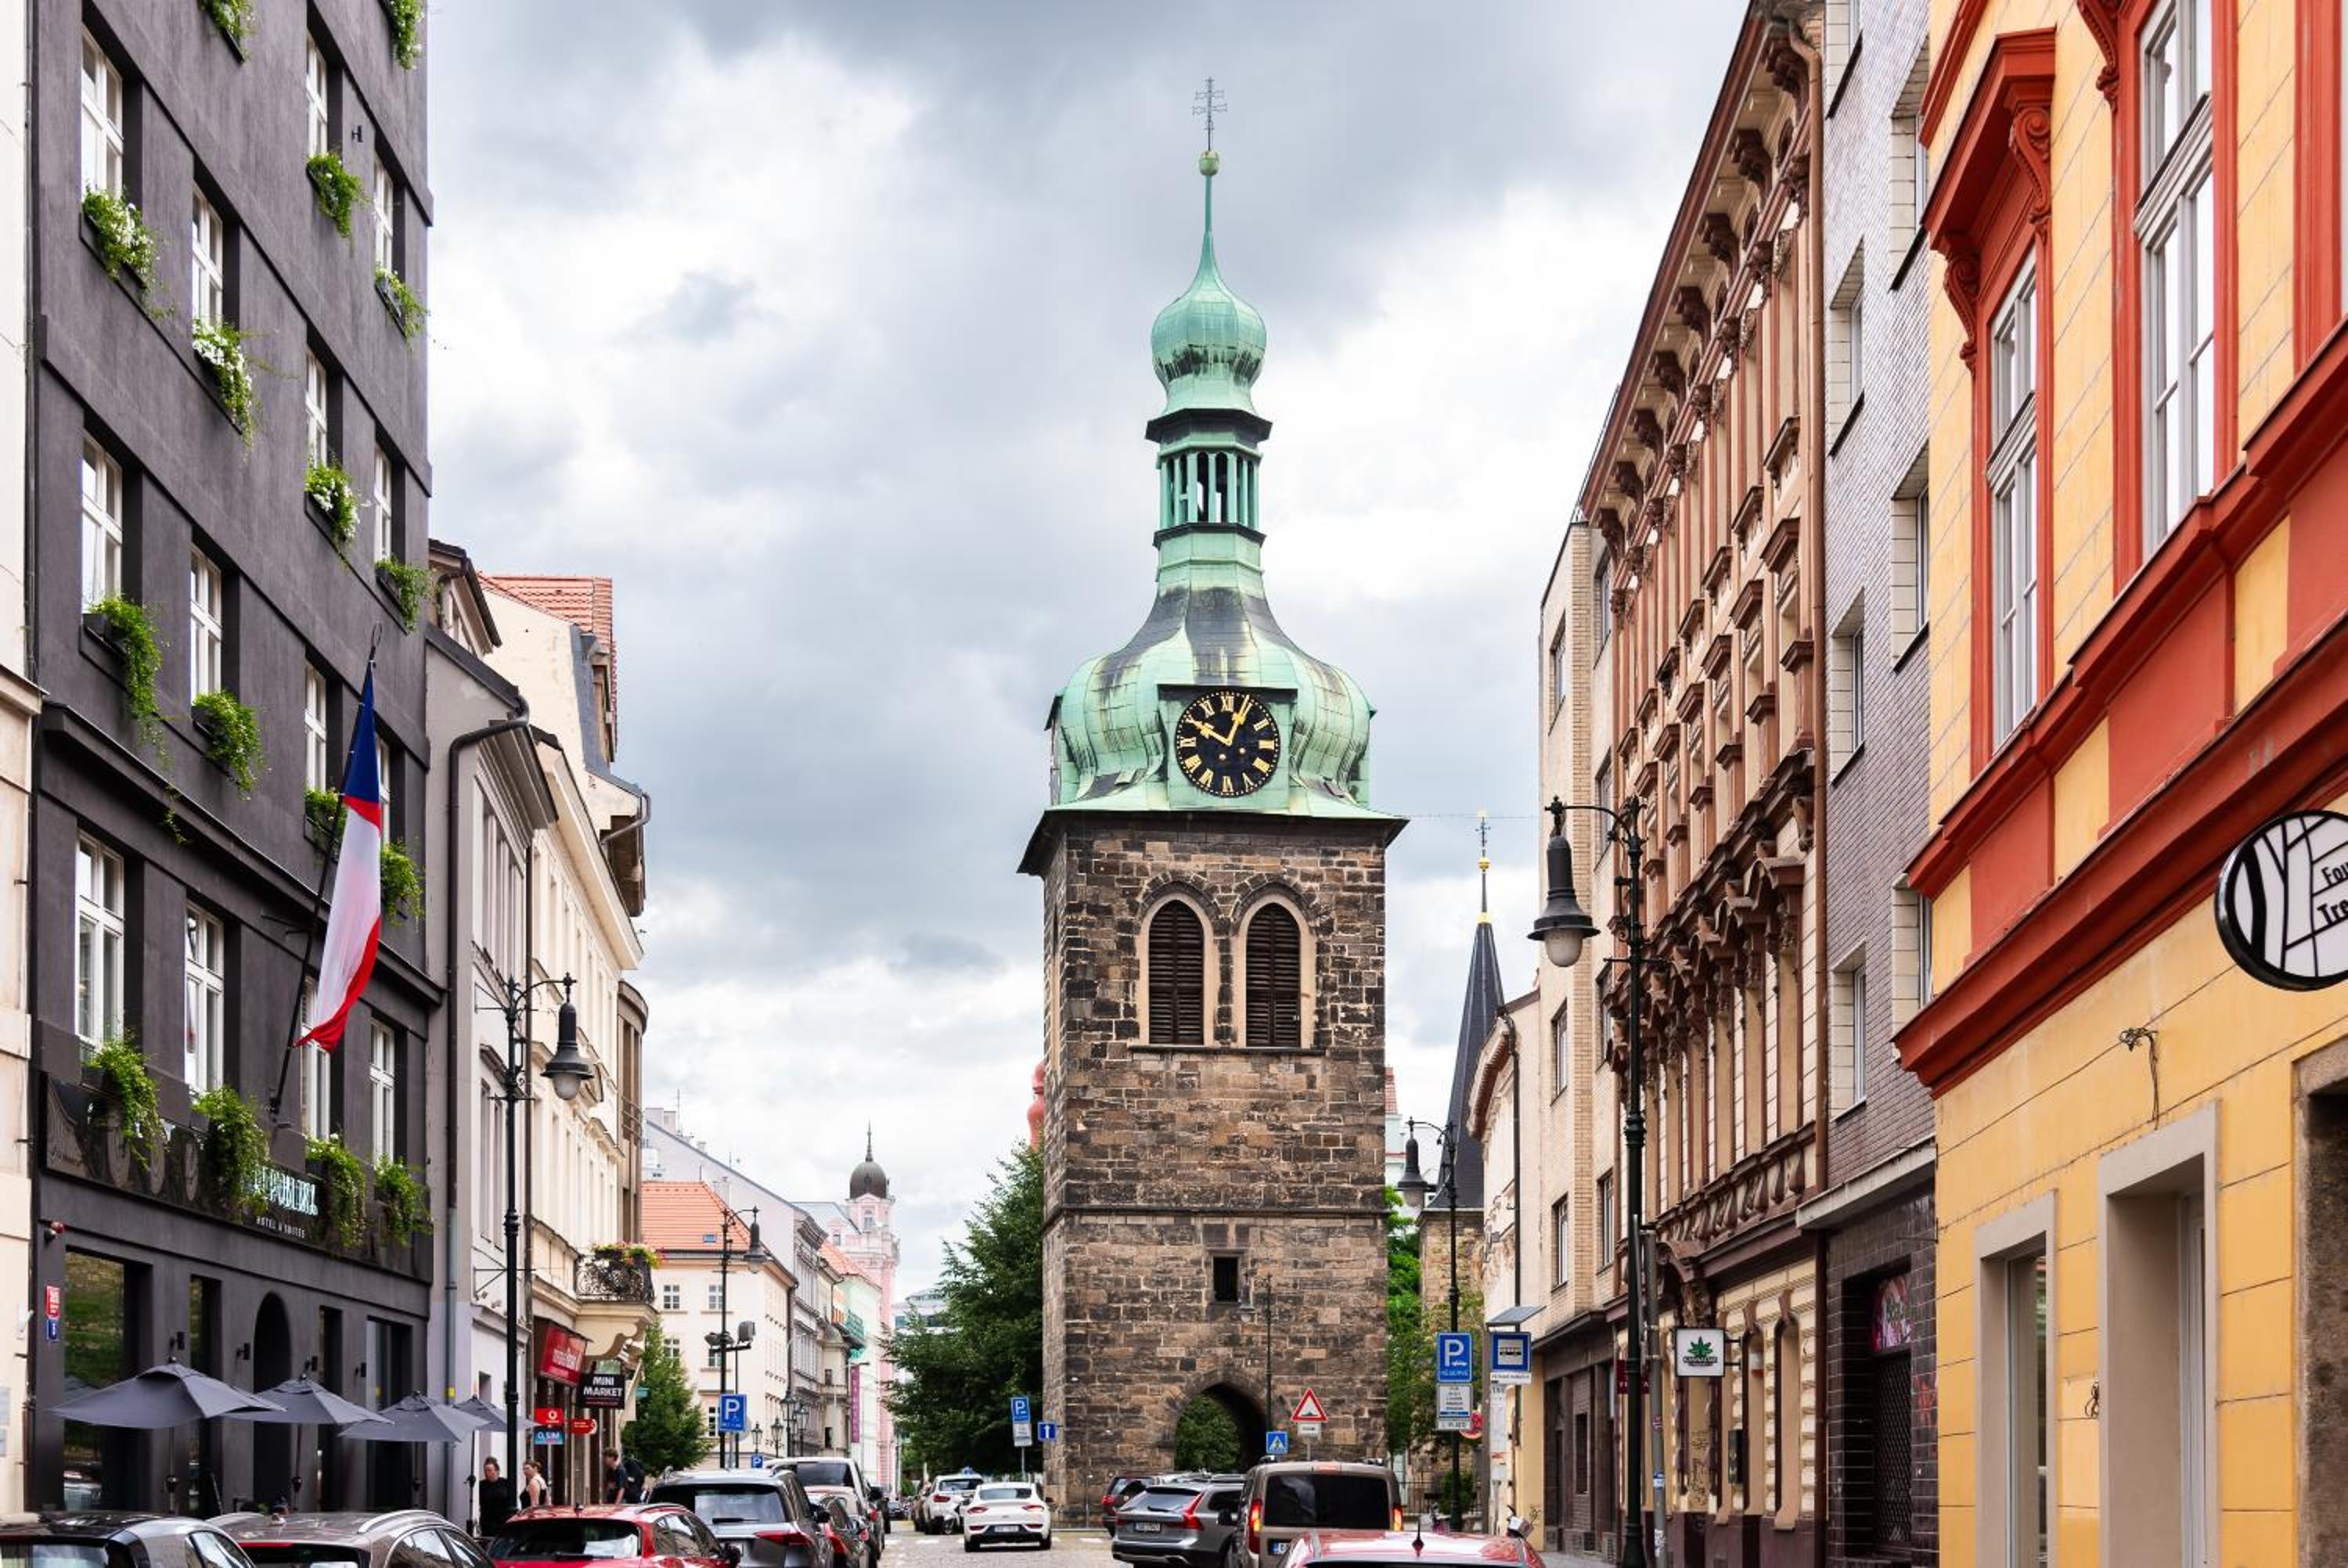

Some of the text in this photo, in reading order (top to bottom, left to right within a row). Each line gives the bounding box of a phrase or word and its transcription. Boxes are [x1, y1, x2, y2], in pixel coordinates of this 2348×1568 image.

[1220, 696, 1234, 713] XII
[1444, 1339, 1464, 1367] P
[592, 1376, 614, 1386] MINI
[583, 1386, 623, 1397] MARKET
[725, 1398, 740, 1420] P
[1015, 1400, 1025, 1415] P
[752, 1456, 762, 1468] P
